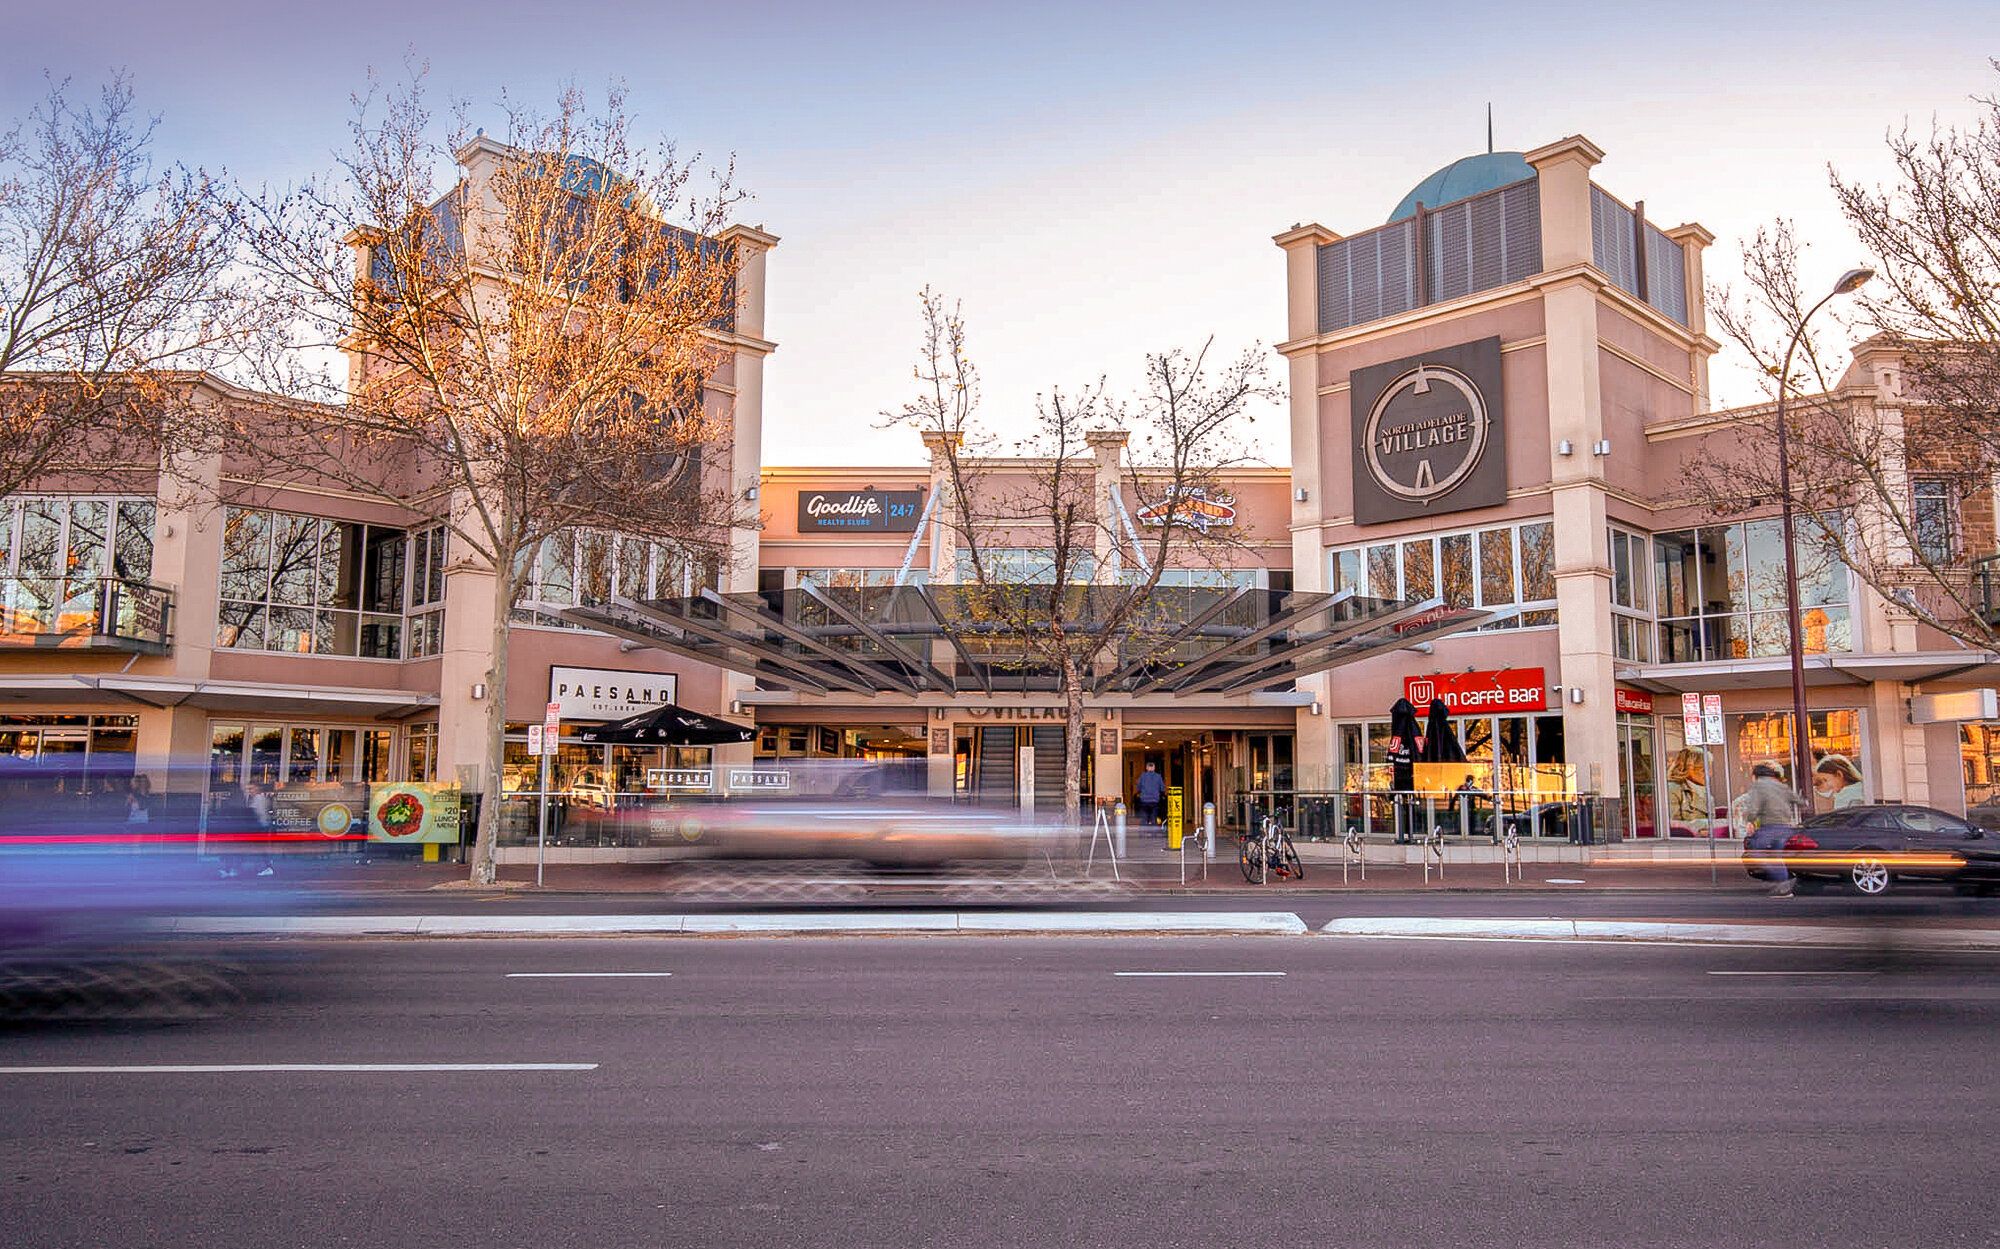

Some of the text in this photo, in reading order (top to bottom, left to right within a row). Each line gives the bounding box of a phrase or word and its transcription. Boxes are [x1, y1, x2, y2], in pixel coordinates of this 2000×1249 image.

[1381, 412, 1467, 438] NORTH ADELAIDE
[1382, 422, 1468, 455] VILLAGE
[559, 683, 669, 702] PAESANO
[994, 707, 1069, 719] VILLAG
[650, 774, 709, 783] PAESANO
[733, 776, 786, 784] PAESANO
[276, 808, 300, 817] FREE
[276, 818, 312, 826] COFFEE
